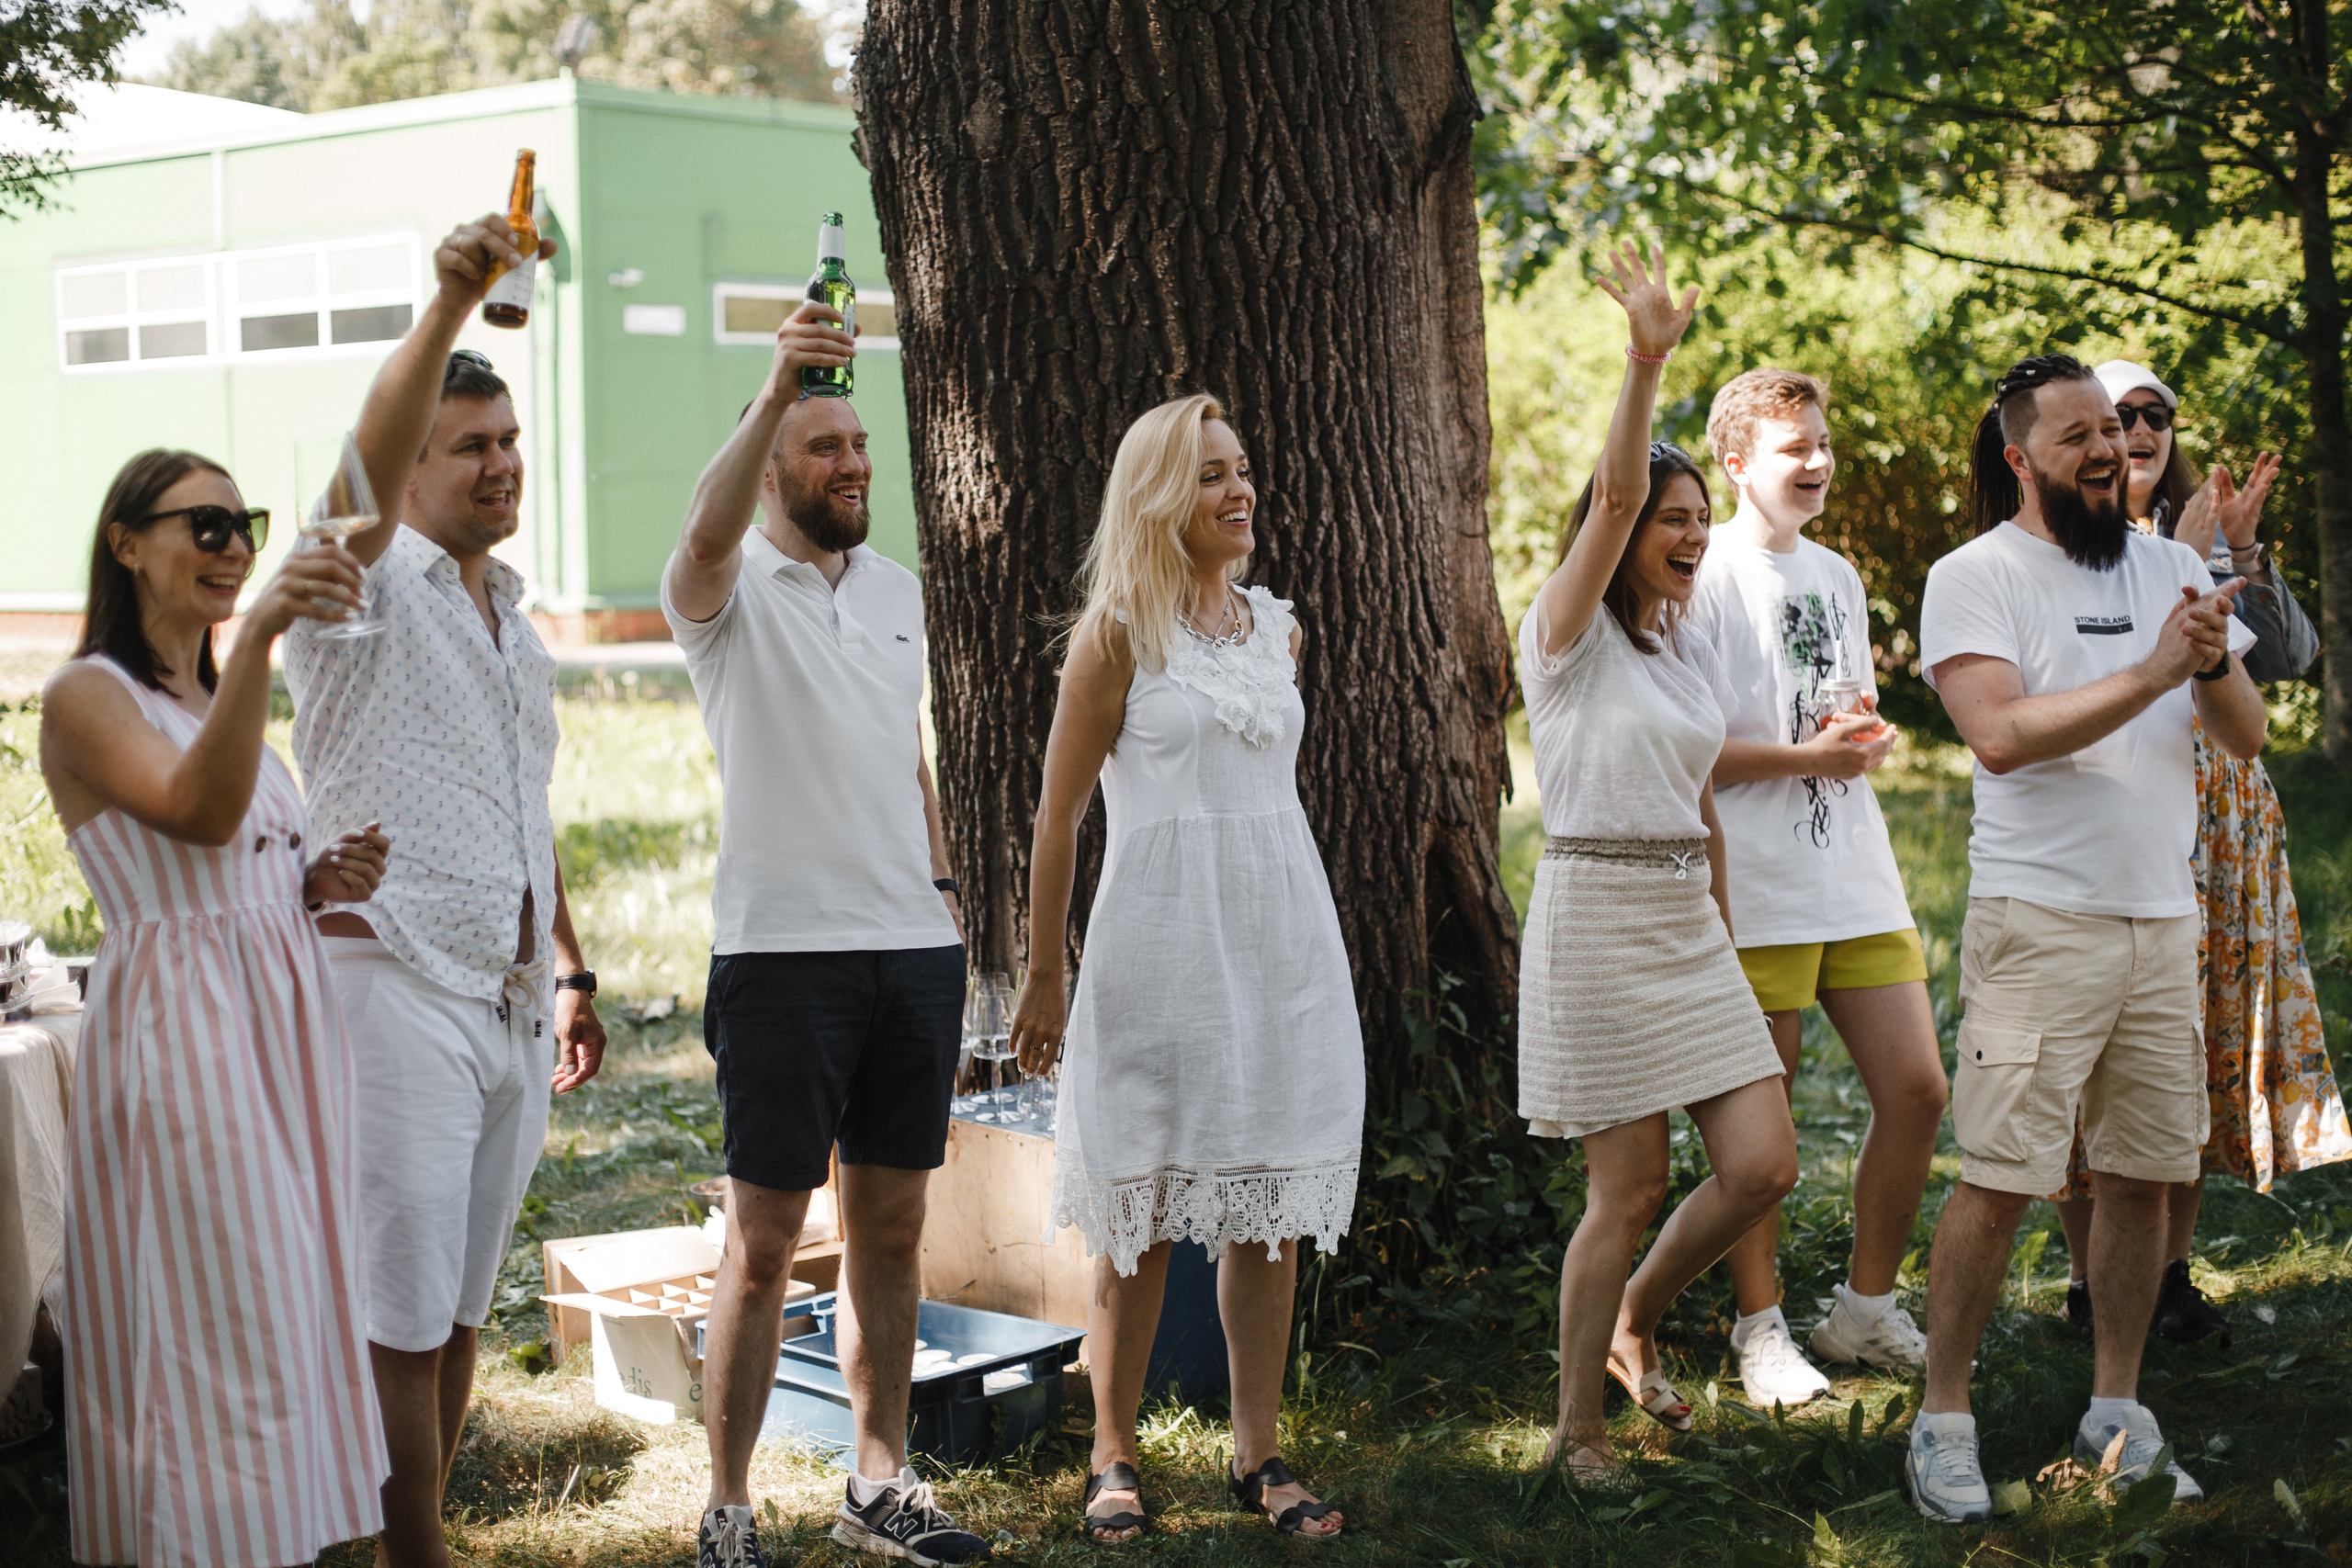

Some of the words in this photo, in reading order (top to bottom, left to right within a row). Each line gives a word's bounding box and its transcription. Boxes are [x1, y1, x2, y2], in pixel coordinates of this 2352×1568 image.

[2075, 616, 2099, 625] STONE
[2100, 615, 2131, 625] ISLAND
[884, 1509, 918, 1540] N
